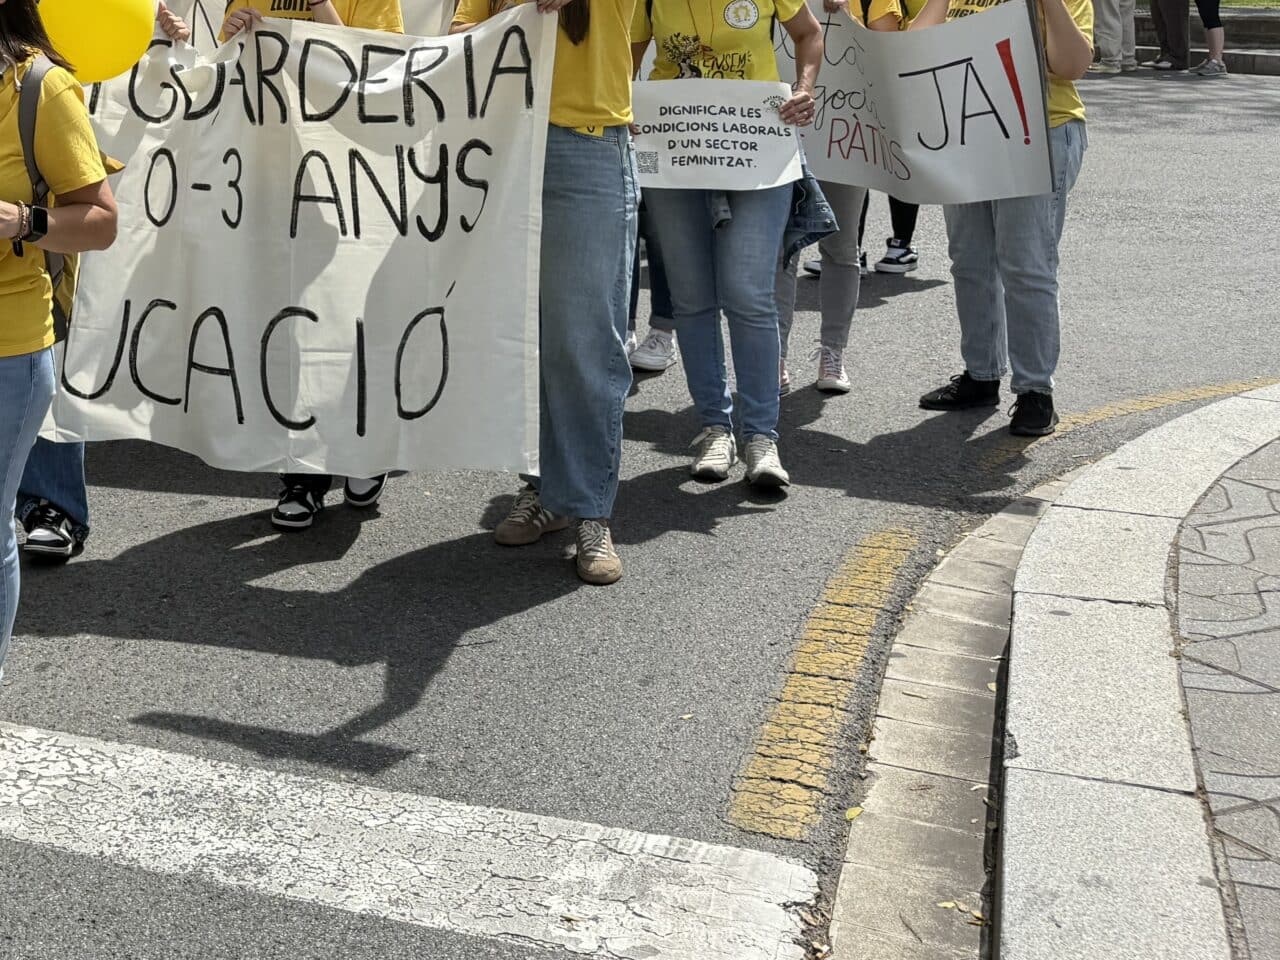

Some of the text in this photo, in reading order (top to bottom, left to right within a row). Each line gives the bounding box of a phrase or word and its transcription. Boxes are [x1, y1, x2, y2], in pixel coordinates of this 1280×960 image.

[898, 38, 1031, 151] JA!
[659, 104, 762, 118] DIGNIFICAR LES
[635, 122, 792, 137] CONDICIONS LABORALS
[668, 139, 759, 151] D'UN SECTOR
[671, 155, 757, 169] FEMINITZAT.
[144, 137, 493, 242] 0-3 ANYS
[61, 281, 457, 438] UCACIÓ
